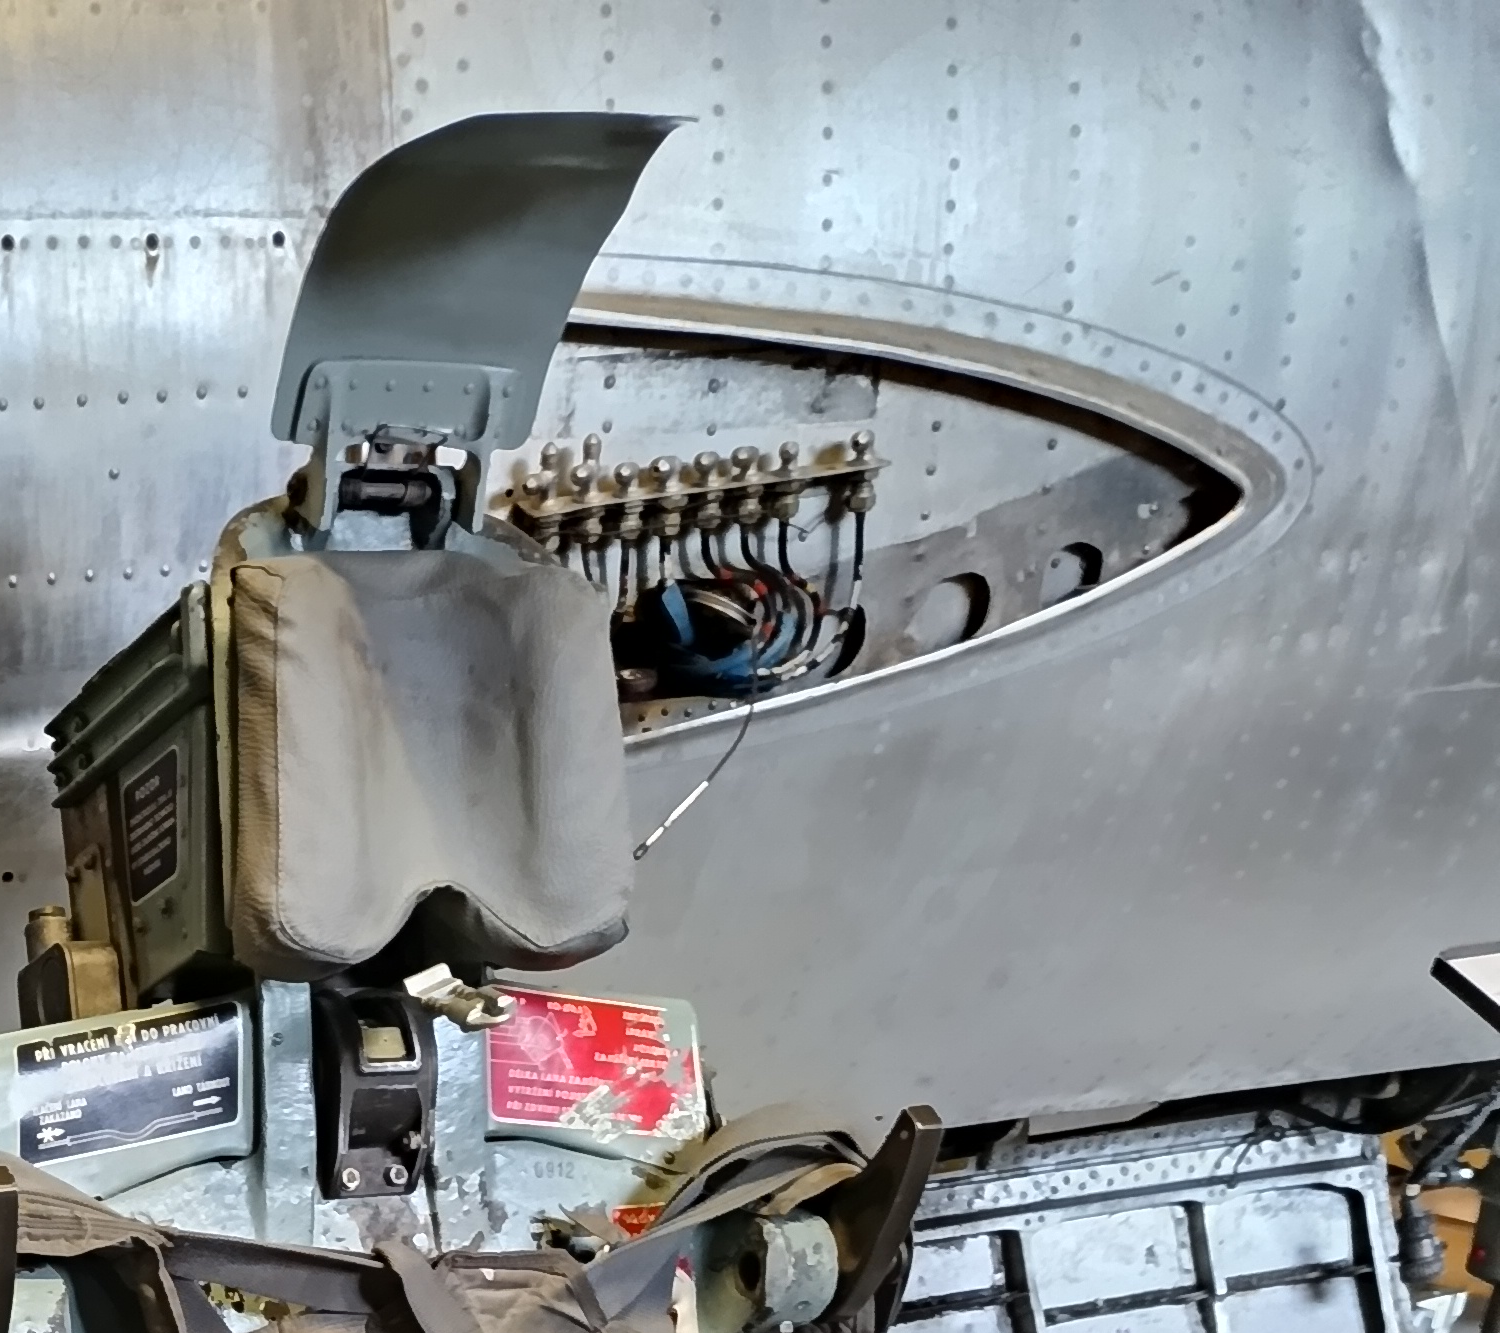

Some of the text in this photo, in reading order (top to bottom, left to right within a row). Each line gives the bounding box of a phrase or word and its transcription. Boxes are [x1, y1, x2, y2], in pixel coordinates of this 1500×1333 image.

[34, 1044, 56, 1063] PŘI
[140, 1027, 159, 1042] DO
[163, 1012, 220, 1037] PRACOVNÍ
